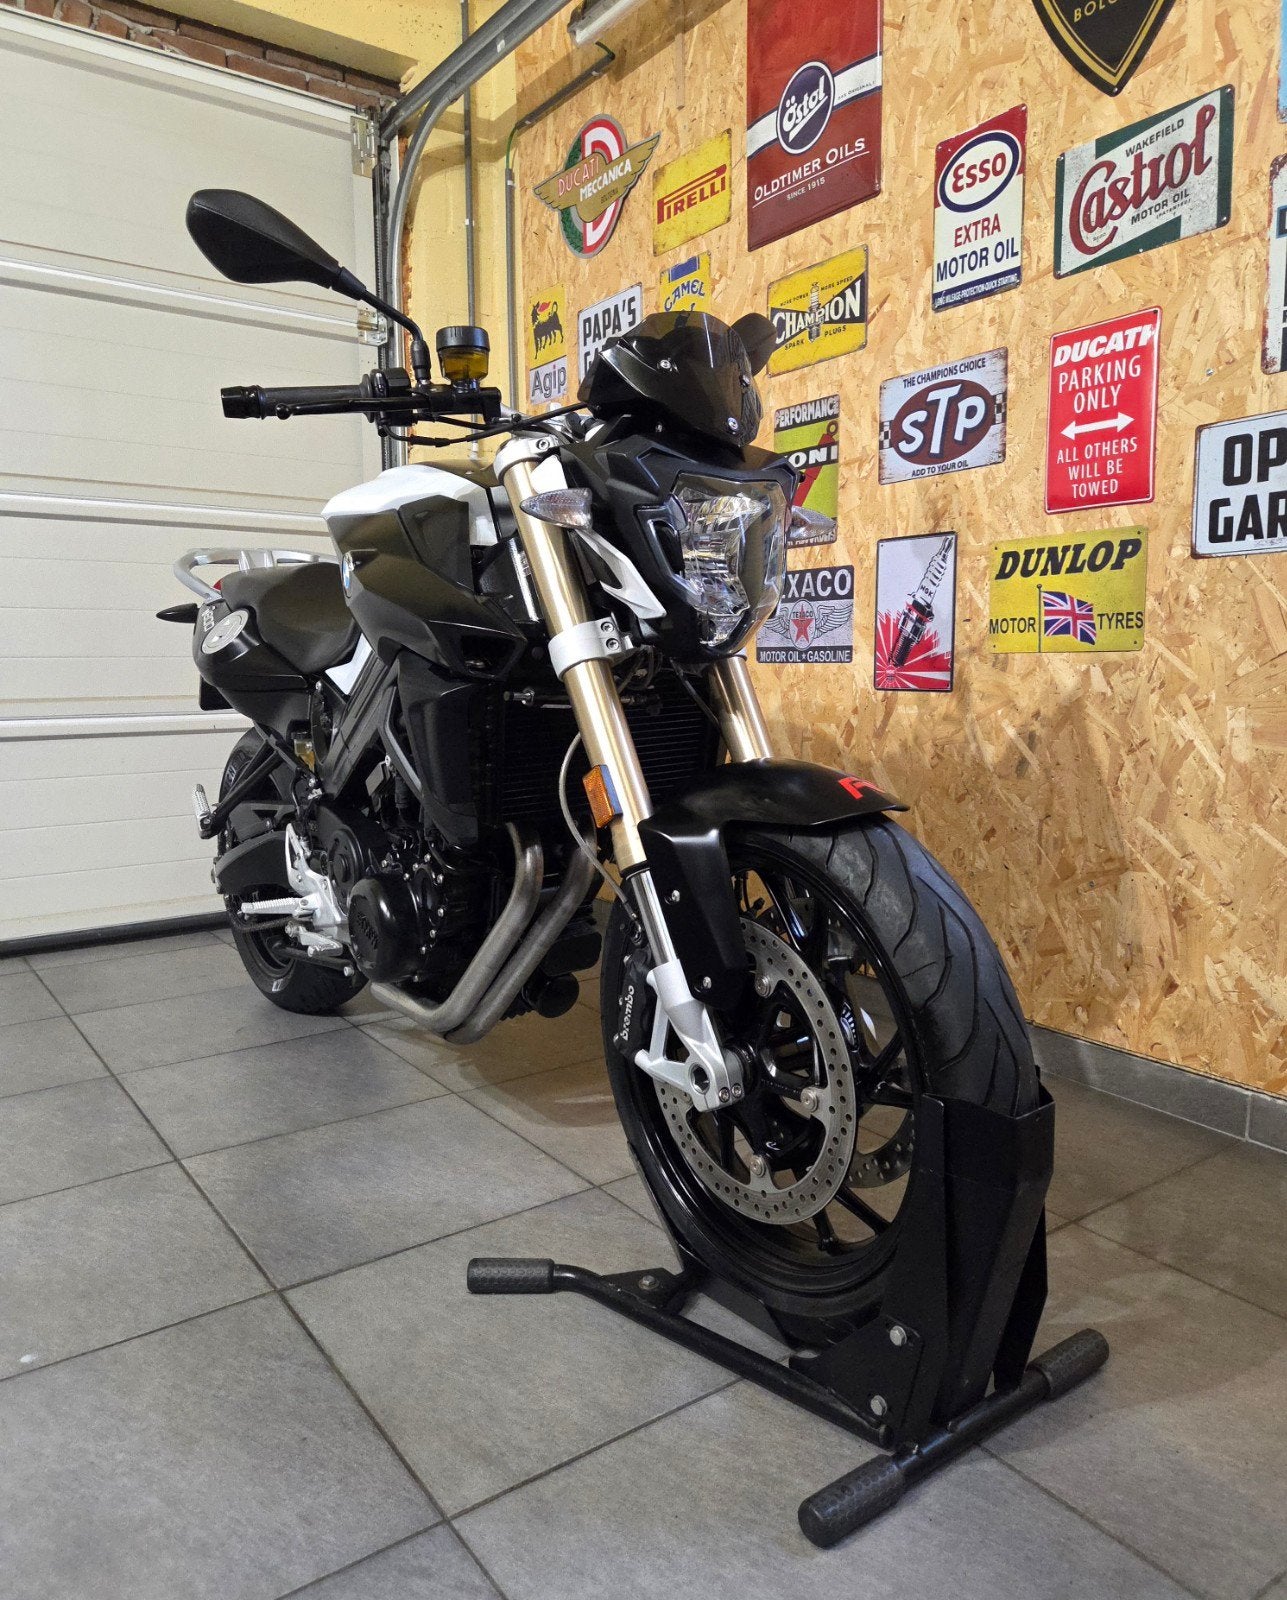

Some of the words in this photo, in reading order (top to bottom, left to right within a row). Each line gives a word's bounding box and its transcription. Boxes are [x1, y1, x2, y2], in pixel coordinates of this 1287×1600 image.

[1074, 0, 1118, 22] BOL
[1125, 118, 1185, 158] WAKEFIELD
[558, 157, 599, 197] DUCATI
[580, 158, 632, 202] MECCANICA
[754, 158, 821, 201] OLDTIMER
[825, 138, 866, 165] OILS
[1069, 104, 1216, 255] Castrol
[657, 163, 727, 225] PIRELLI
[787, 185, 806, 201] SINCE
[807, 176, 826, 191] 1915
[1131, 200, 1168, 225] MOTOR
[1173, 188, 1190, 204] OIL
[954, 213, 1001, 248] EXTRA
[936, 246, 989, 282] MOTOR
[994, 237, 1019, 263] OIL
[664, 279, 706, 312] CAMEL
[772, 279, 861, 344] CHAMPION
[583, 296, 637, 347] PAPA'S
[784, 338, 805, 350] SPARK
[824, 325, 847, 337] PLUGS
[1054, 324, 1157, 367] DUCATI
[531, 364, 567, 399] Agip
[903, 377, 916, 389] THE
[917, 365, 958, 385] CHAMPIONS
[960, 357, 986, 374] CHOICE
[1058, 355, 1141, 393] PARKING
[774, 396, 839, 428] PERFORMANCE
[1073, 384, 1121, 414] ONLY
[898, 383, 986, 454] STP
[788, 444, 838, 468] ONI
[1057, 447, 1078, 464] ALL
[1084, 437, 1138, 459] OTHERS
[1223, 427, 1287, 486] OP
[912, 467, 926, 478] ADD
[927, 466, 937, 475] TO
[937, 462, 957, 472] YOUR
[957, 460, 969, 469] OIL
[1068, 462, 1100, 481] WILL
[1106, 458, 1123, 475] BE
[1072, 479, 1119, 498] TOWED
[1208, 490, 1287, 544] GAR
[995, 538, 1142, 580] DUNLOP
[782, 569, 852, 599] XACO
[792, 610, 814, 619] TEXACO
[989, 617, 1037, 634] MOTOR
[1097, 611, 1144, 630] TYRES
[760, 651, 786, 662] MOTOR
[788, 650, 801, 662] OIL
[807, 650, 851, 662] GASOLINE
[620, 985, 635, 1041] brembo
